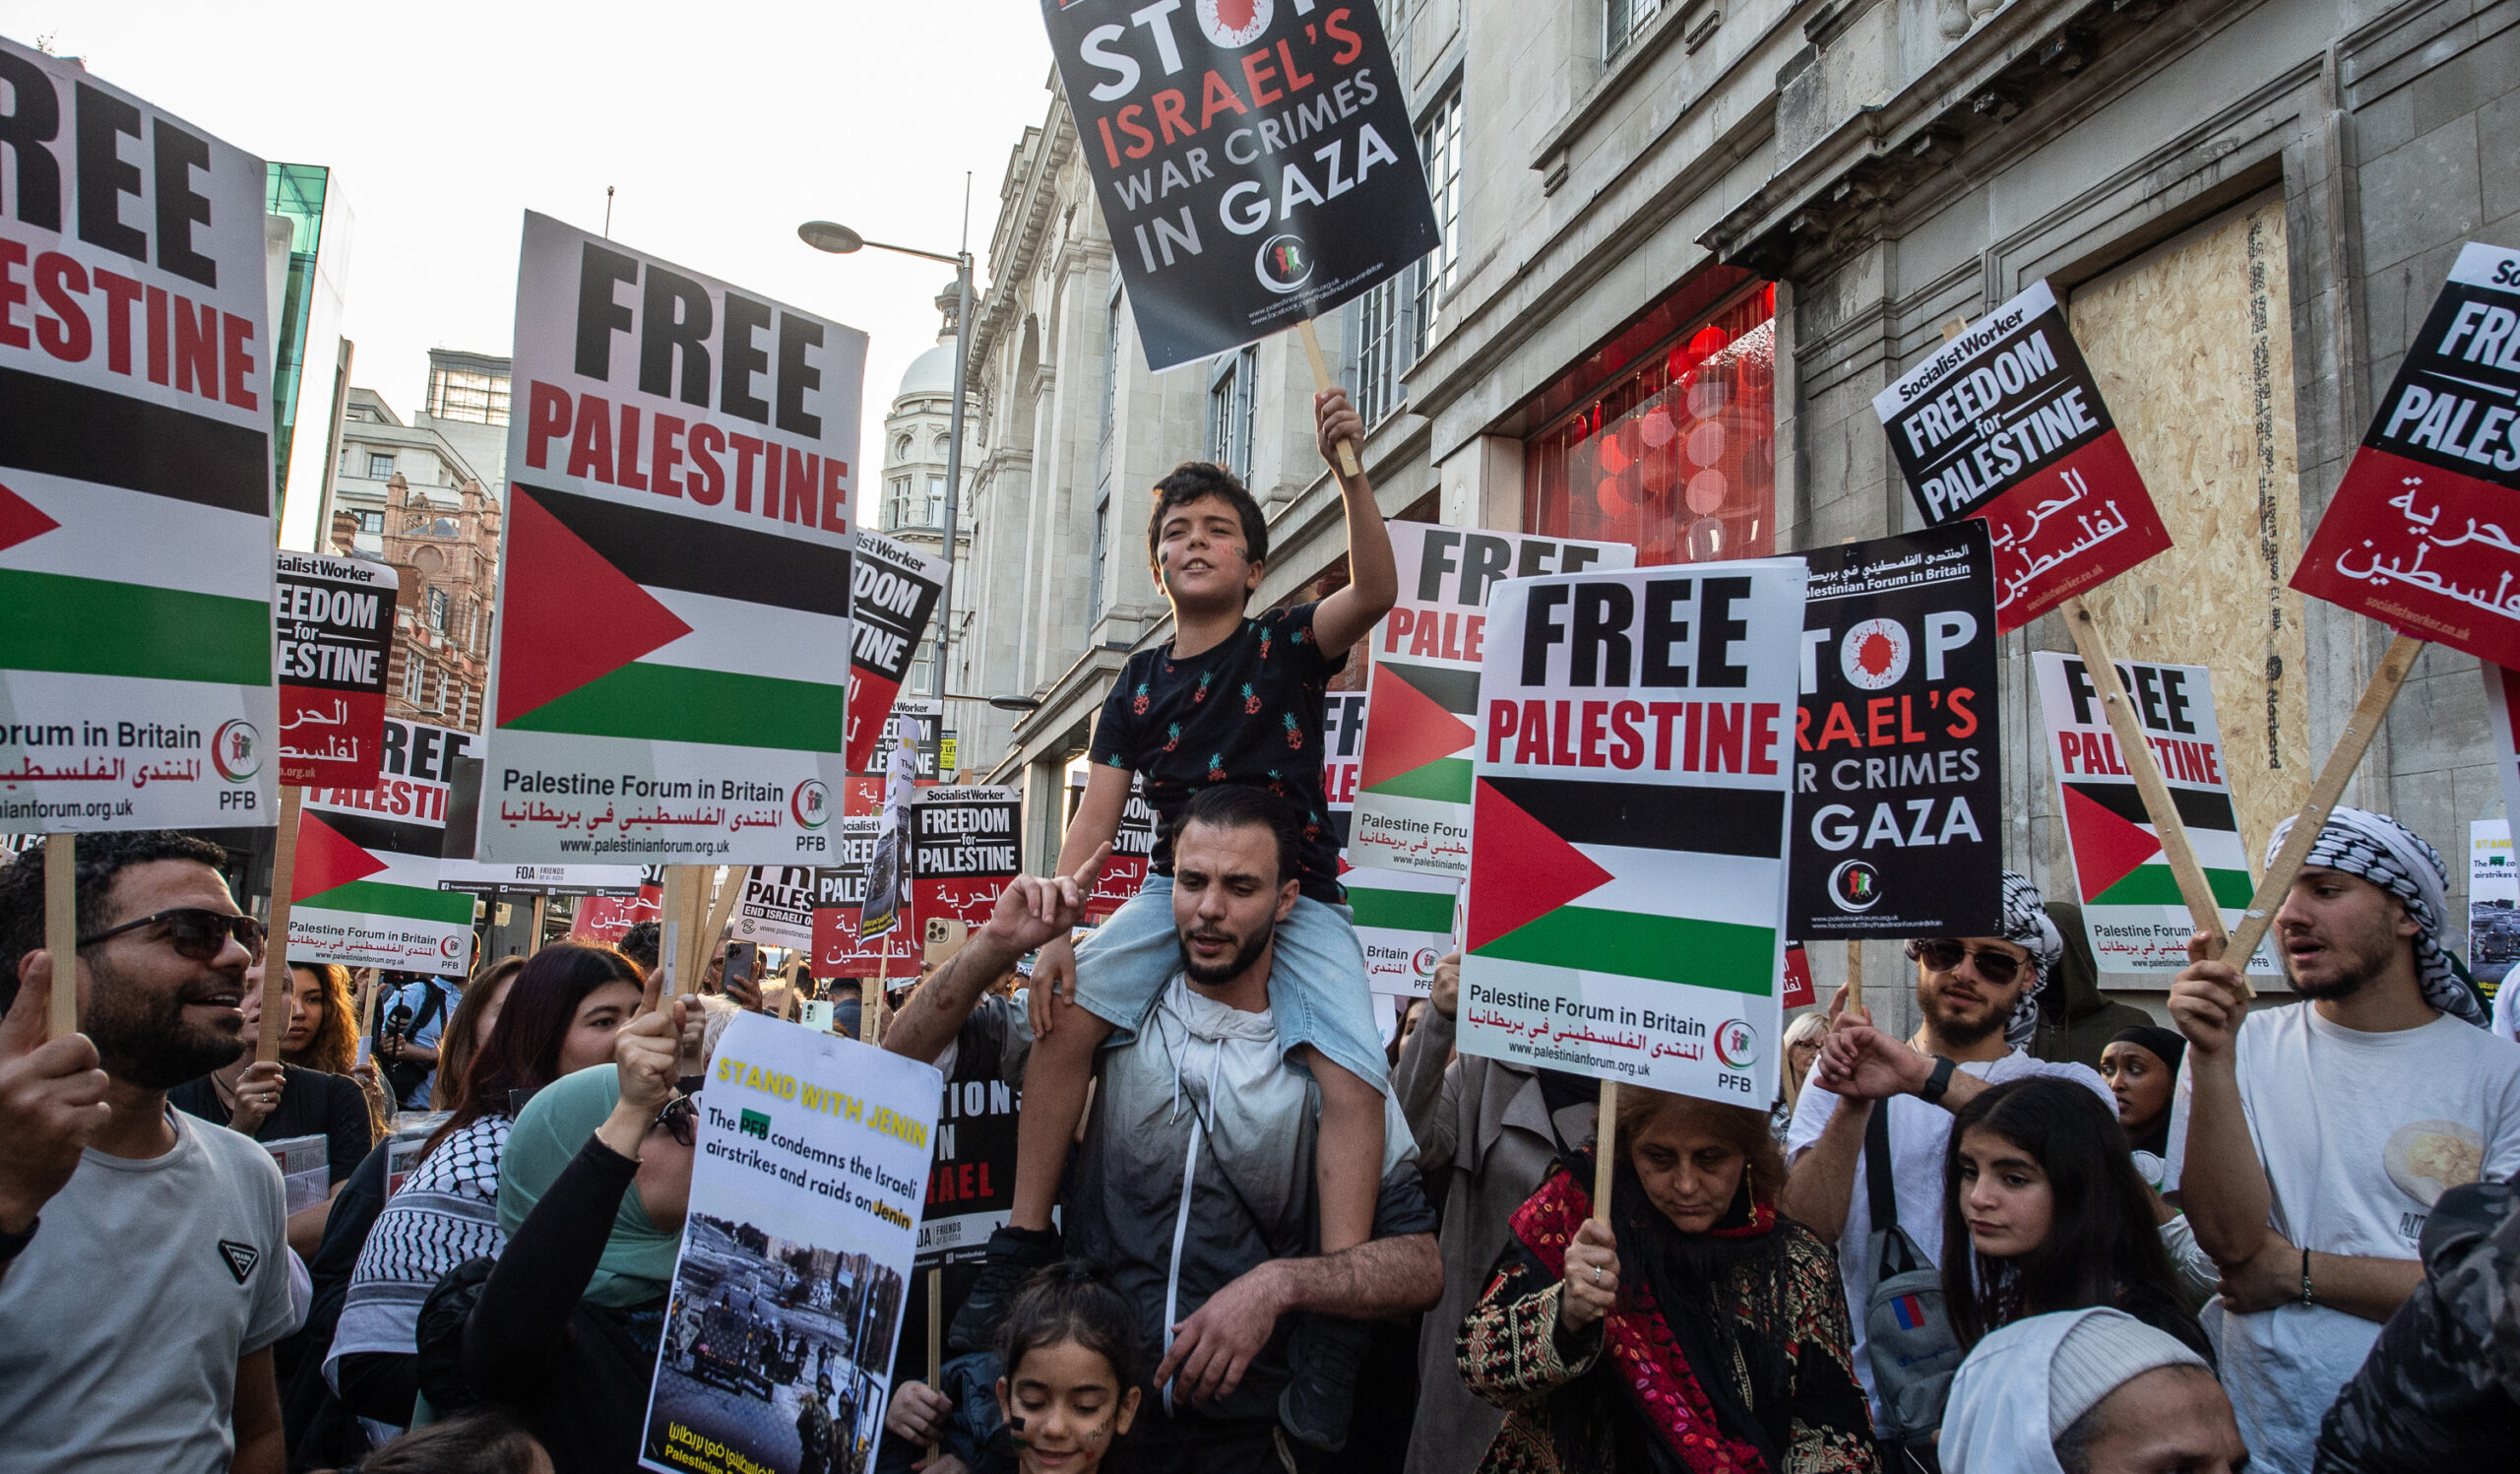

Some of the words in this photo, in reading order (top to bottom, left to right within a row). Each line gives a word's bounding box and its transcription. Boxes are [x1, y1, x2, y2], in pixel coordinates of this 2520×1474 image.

[1097, 8, 1362, 169] ISRAEL'S
[1113, 146, 1215, 212] WAR
[1225, 69, 1379, 164] CRIMES
[1133, 205, 1203, 275] IN
[1219, 122, 1400, 236] GAZA
[576, 241, 824, 439] FREE
[1903, 329, 2058, 459] FREEDOM
[1975, 411, 2002, 440] for
[526, 379, 848, 535] PALESTINE
[1922, 386, 2098, 523] PALESTINE
[1992, 468, 2088, 551] الحري
[1866, 576, 1908, 591] Forum
[1910, 571, 1923, 583] in
[1925, 563, 1971, 581] Britain
[294, 621, 320, 640] for
[1520, 576, 1753, 688] FREE
[84, 721, 108, 747] in
[117, 722, 202, 749] Britain
[1485, 699, 1781, 776] PALESTINE
[132, 758, 201, 789] المنتدى
[1831, 747, 1981, 794] CRIMES
[503, 769, 615, 796] Palestine
[621, 775, 692, 800] Forum
[697, 777, 715, 800] in
[722, 780, 785, 802] Britain
[0, 799, 134, 820] ianforum.org.uk
[220, 791, 257, 810] PFB
[500, 800, 581, 830] بريطانيا
[586, 801, 614, 838] في
[618, 805, 725, 838] الفلسطيني
[729, 808, 783, 832] المنتدى
[921, 807, 1010, 834] FREEDOM
[1360, 812, 1430, 834] Palestine
[1810, 796, 1983, 852] GAZA
[560, 837, 730, 856] www.palestinianforum.org.uk
[795, 836, 826, 852] PFB
[961, 833, 976, 846] for
[516, 866, 535, 879] FOA
[539, 866, 564, 875] FRIENDS
[917, 846, 1016, 873] PALESTINE
[744, 906, 765, 918] END
[766, 908, 803, 925] ISRAELI
[288, 921, 345, 935] Palestine
[347, 927, 386, 940] Forum
[388, 929, 400, 940] in
[401, 931, 437, 946] Britain
[2094, 925, 2152, 936] Palestine
[2154, 926, 2192, 936] Forum
[315, 950, 406, 966] www.palestinianforum.org.uk
[441, 960, 459, 970] PFB
[1367, 945, 1409, 960] Britain
[2251, 957, 2270, 968] PFB
[1468, 1006, 1525, 1035] بريطانيا
[1470, 984, 1550, 1012] Palestine
[1554, 996, 1614, 1023] Forum
[1620, 1005, 1637, 1026] in
[1643, 1009, 1706, 1038] Britain
[1528, 1015, 1549, 1045] في
[1553, 1025, 1647, 1051] الفلسطيني
[1509, 1041, 1651, 1077] www.palestinianforum.org.uk
[1651, 1043, 1704, 1061] المنتدى
[1718, 1072, 1752, 1093] PFB
[717, 1057, 797, 1100] STAND
[801, 1080, 864, 1123] WITH
[866, 1104, 928, 1151] JENIN
[709, 1107, 735, 1131] The
[740, 1116, 769, 1140] PFB
[771, 1132, 847, 1170] condemns
[850, 1155, 872, 1181] the
[875, 1165, 917, 1200] Israeli
[706, 1140, 777, 1176] airstrikes
[780, 1170, 807, 1188] and
[809, 1179, 852, 1204] raids
[854, 1194, 872, 1214] on
[873, 1199, 911, 1231] Jenin
[936, 1222, 962, 1235] FRIENDS
